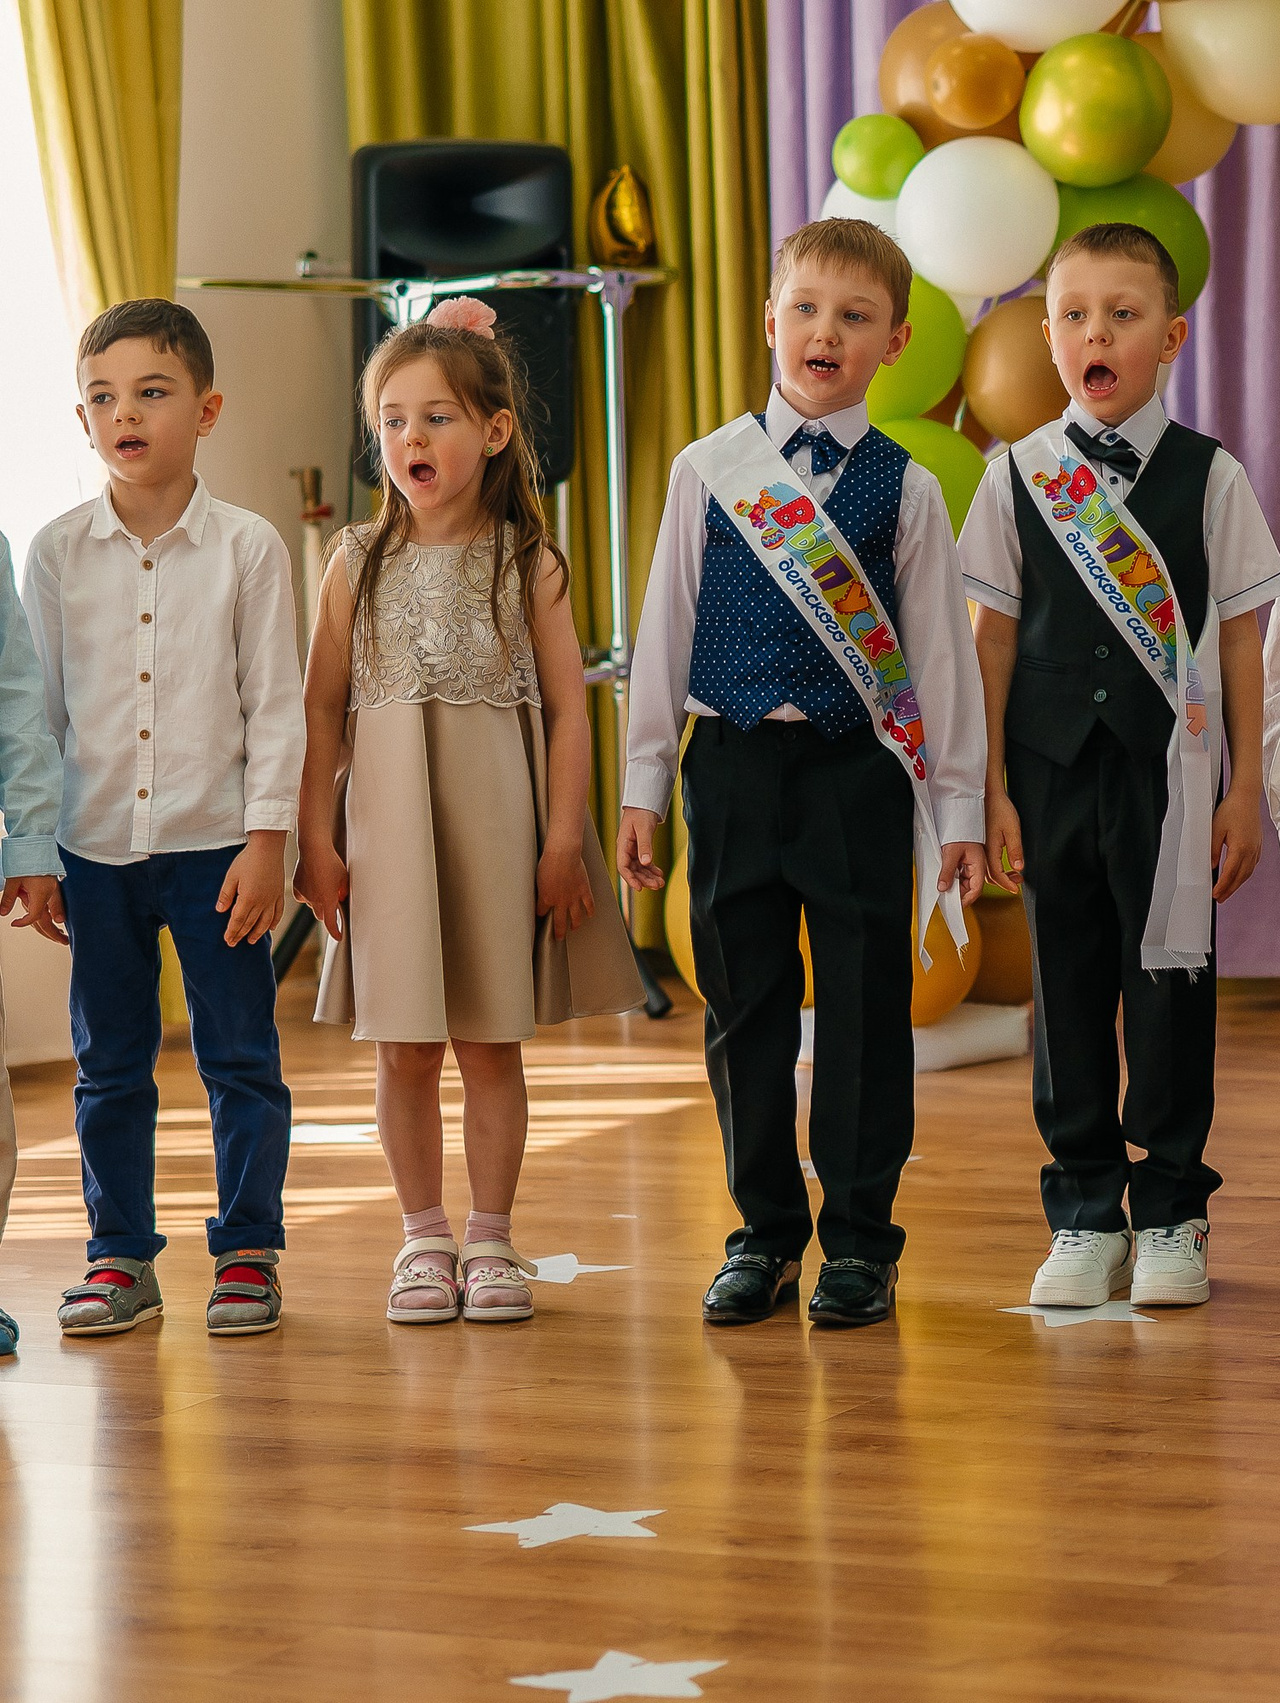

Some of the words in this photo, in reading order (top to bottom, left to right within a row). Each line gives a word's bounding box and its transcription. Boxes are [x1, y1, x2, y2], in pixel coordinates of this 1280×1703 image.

[777, 557, 847, 643] детского
[842, 646, 875, 690] сада
[1066, 531, 1132, 614] детского
[1126, 617, 1162, 662] сада
